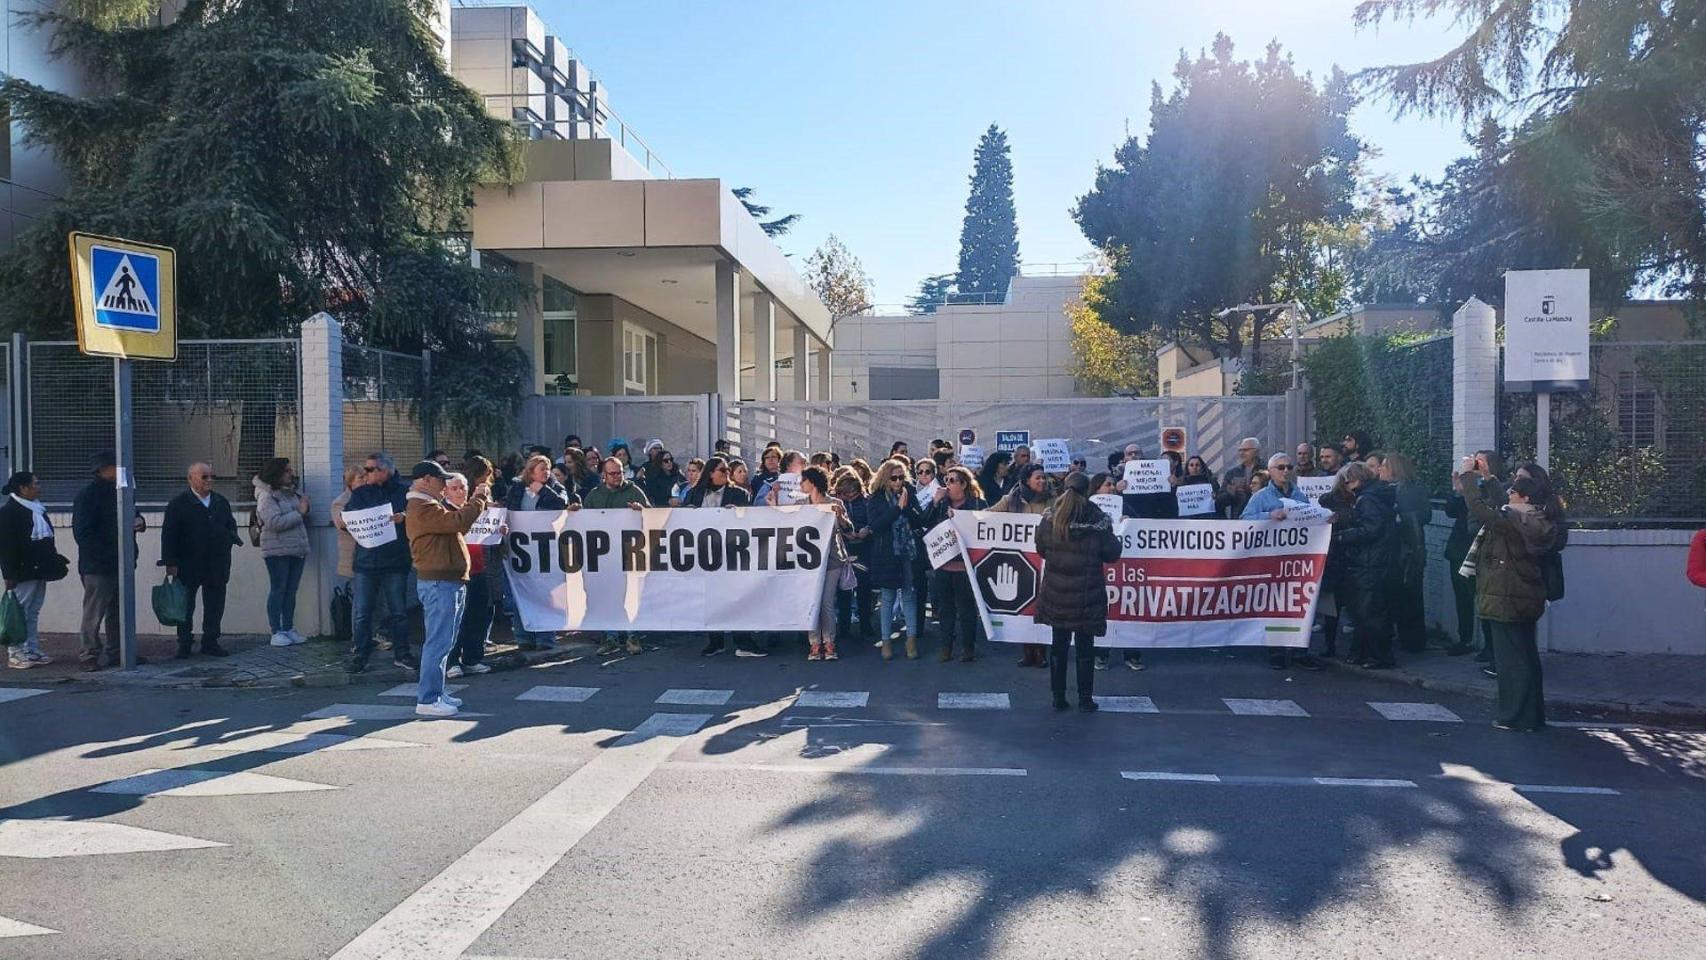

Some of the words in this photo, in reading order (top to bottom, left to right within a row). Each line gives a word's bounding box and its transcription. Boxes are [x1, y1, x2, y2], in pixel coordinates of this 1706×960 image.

[510, 530, 610, 574] STOP
[622, 526, 822, 572] RECORTES
[977, 522, 996, 540] En
[1137, 530, 1226, 550] SERVICIOS
[1232, 526, 1308, 550] PÚBLICOS
[1107, 568, 1116, 582] a
[1122, 563, 1145, 582] las
[1276, 560, 1314, 578] JCCM
[1106, 581, 1318, 617] PRIVATIZACIONES
